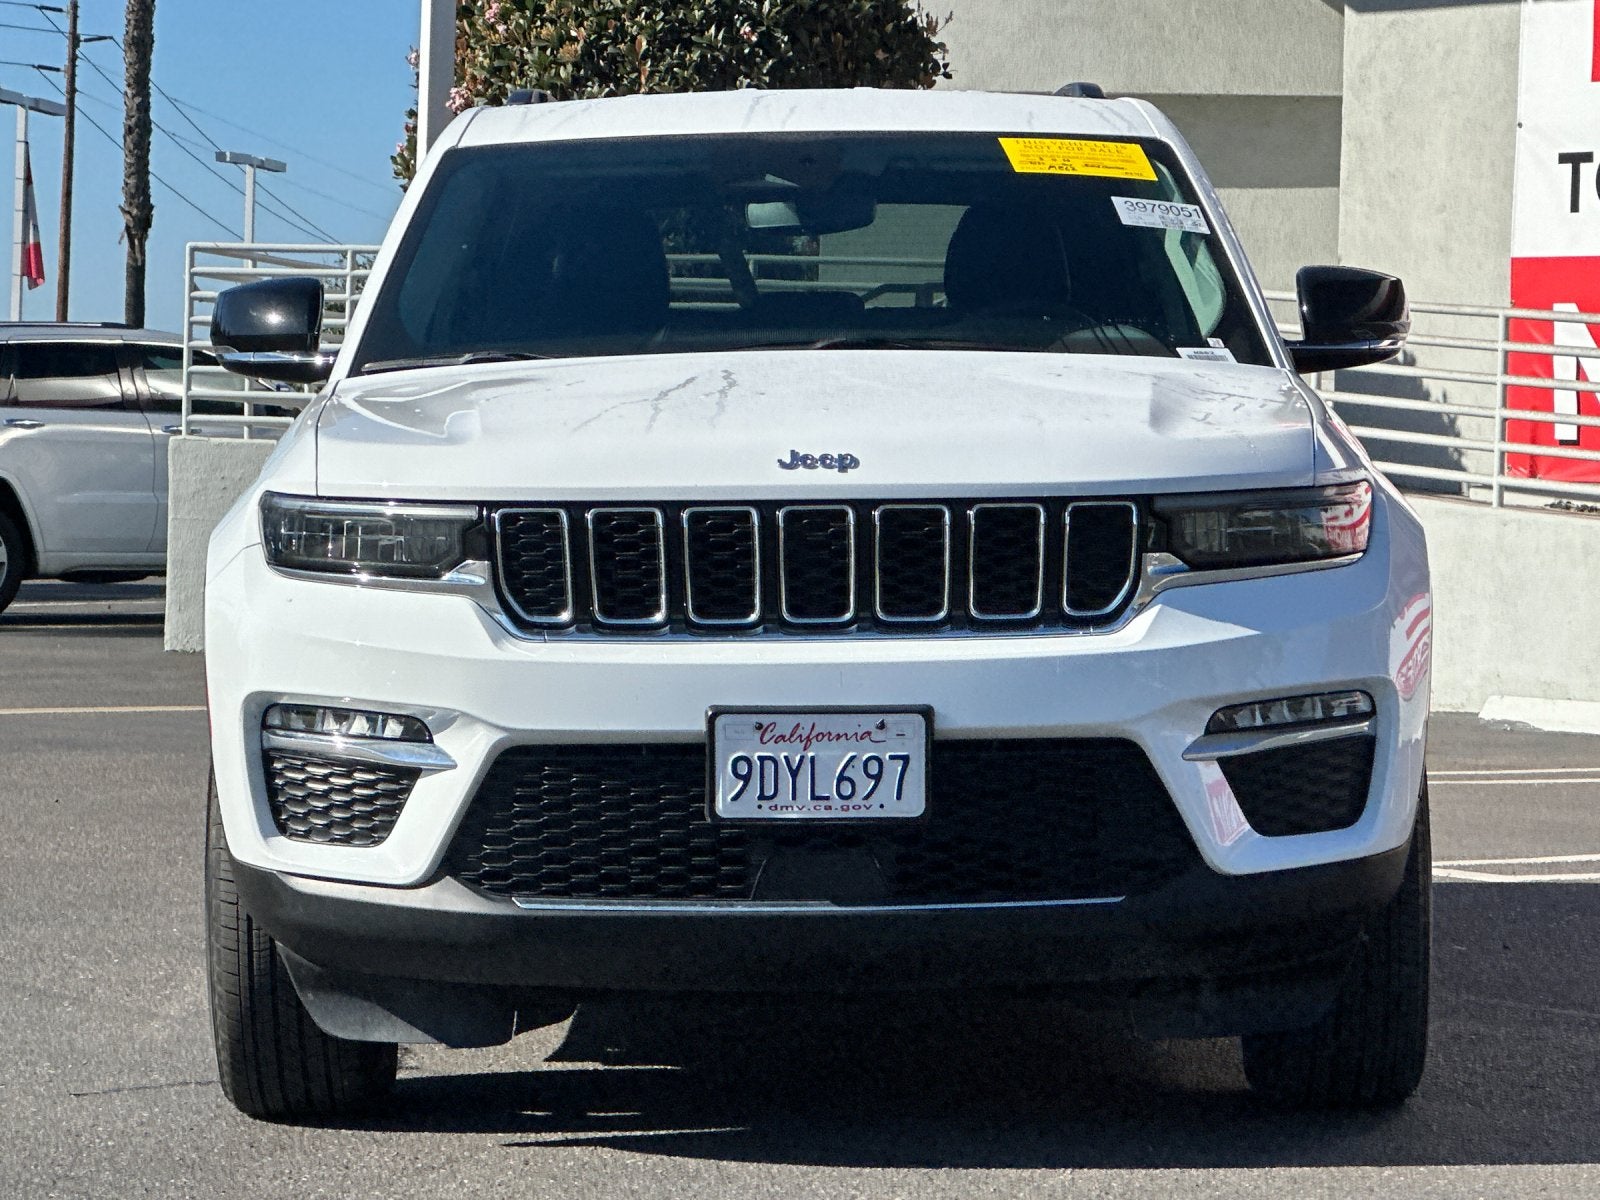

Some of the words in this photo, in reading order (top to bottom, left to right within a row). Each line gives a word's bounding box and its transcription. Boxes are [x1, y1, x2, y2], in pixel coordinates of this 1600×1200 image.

[1558, 151, 1600, 213] T
[1124, 200, 1201, 219] 3979051
[777, 449, 860, 473] Jeep
[759, 722, 886, 751] California
[729, 753, 910, 802] 9DYL697
[768, 803, 873, 812] dmv.ca.gov
